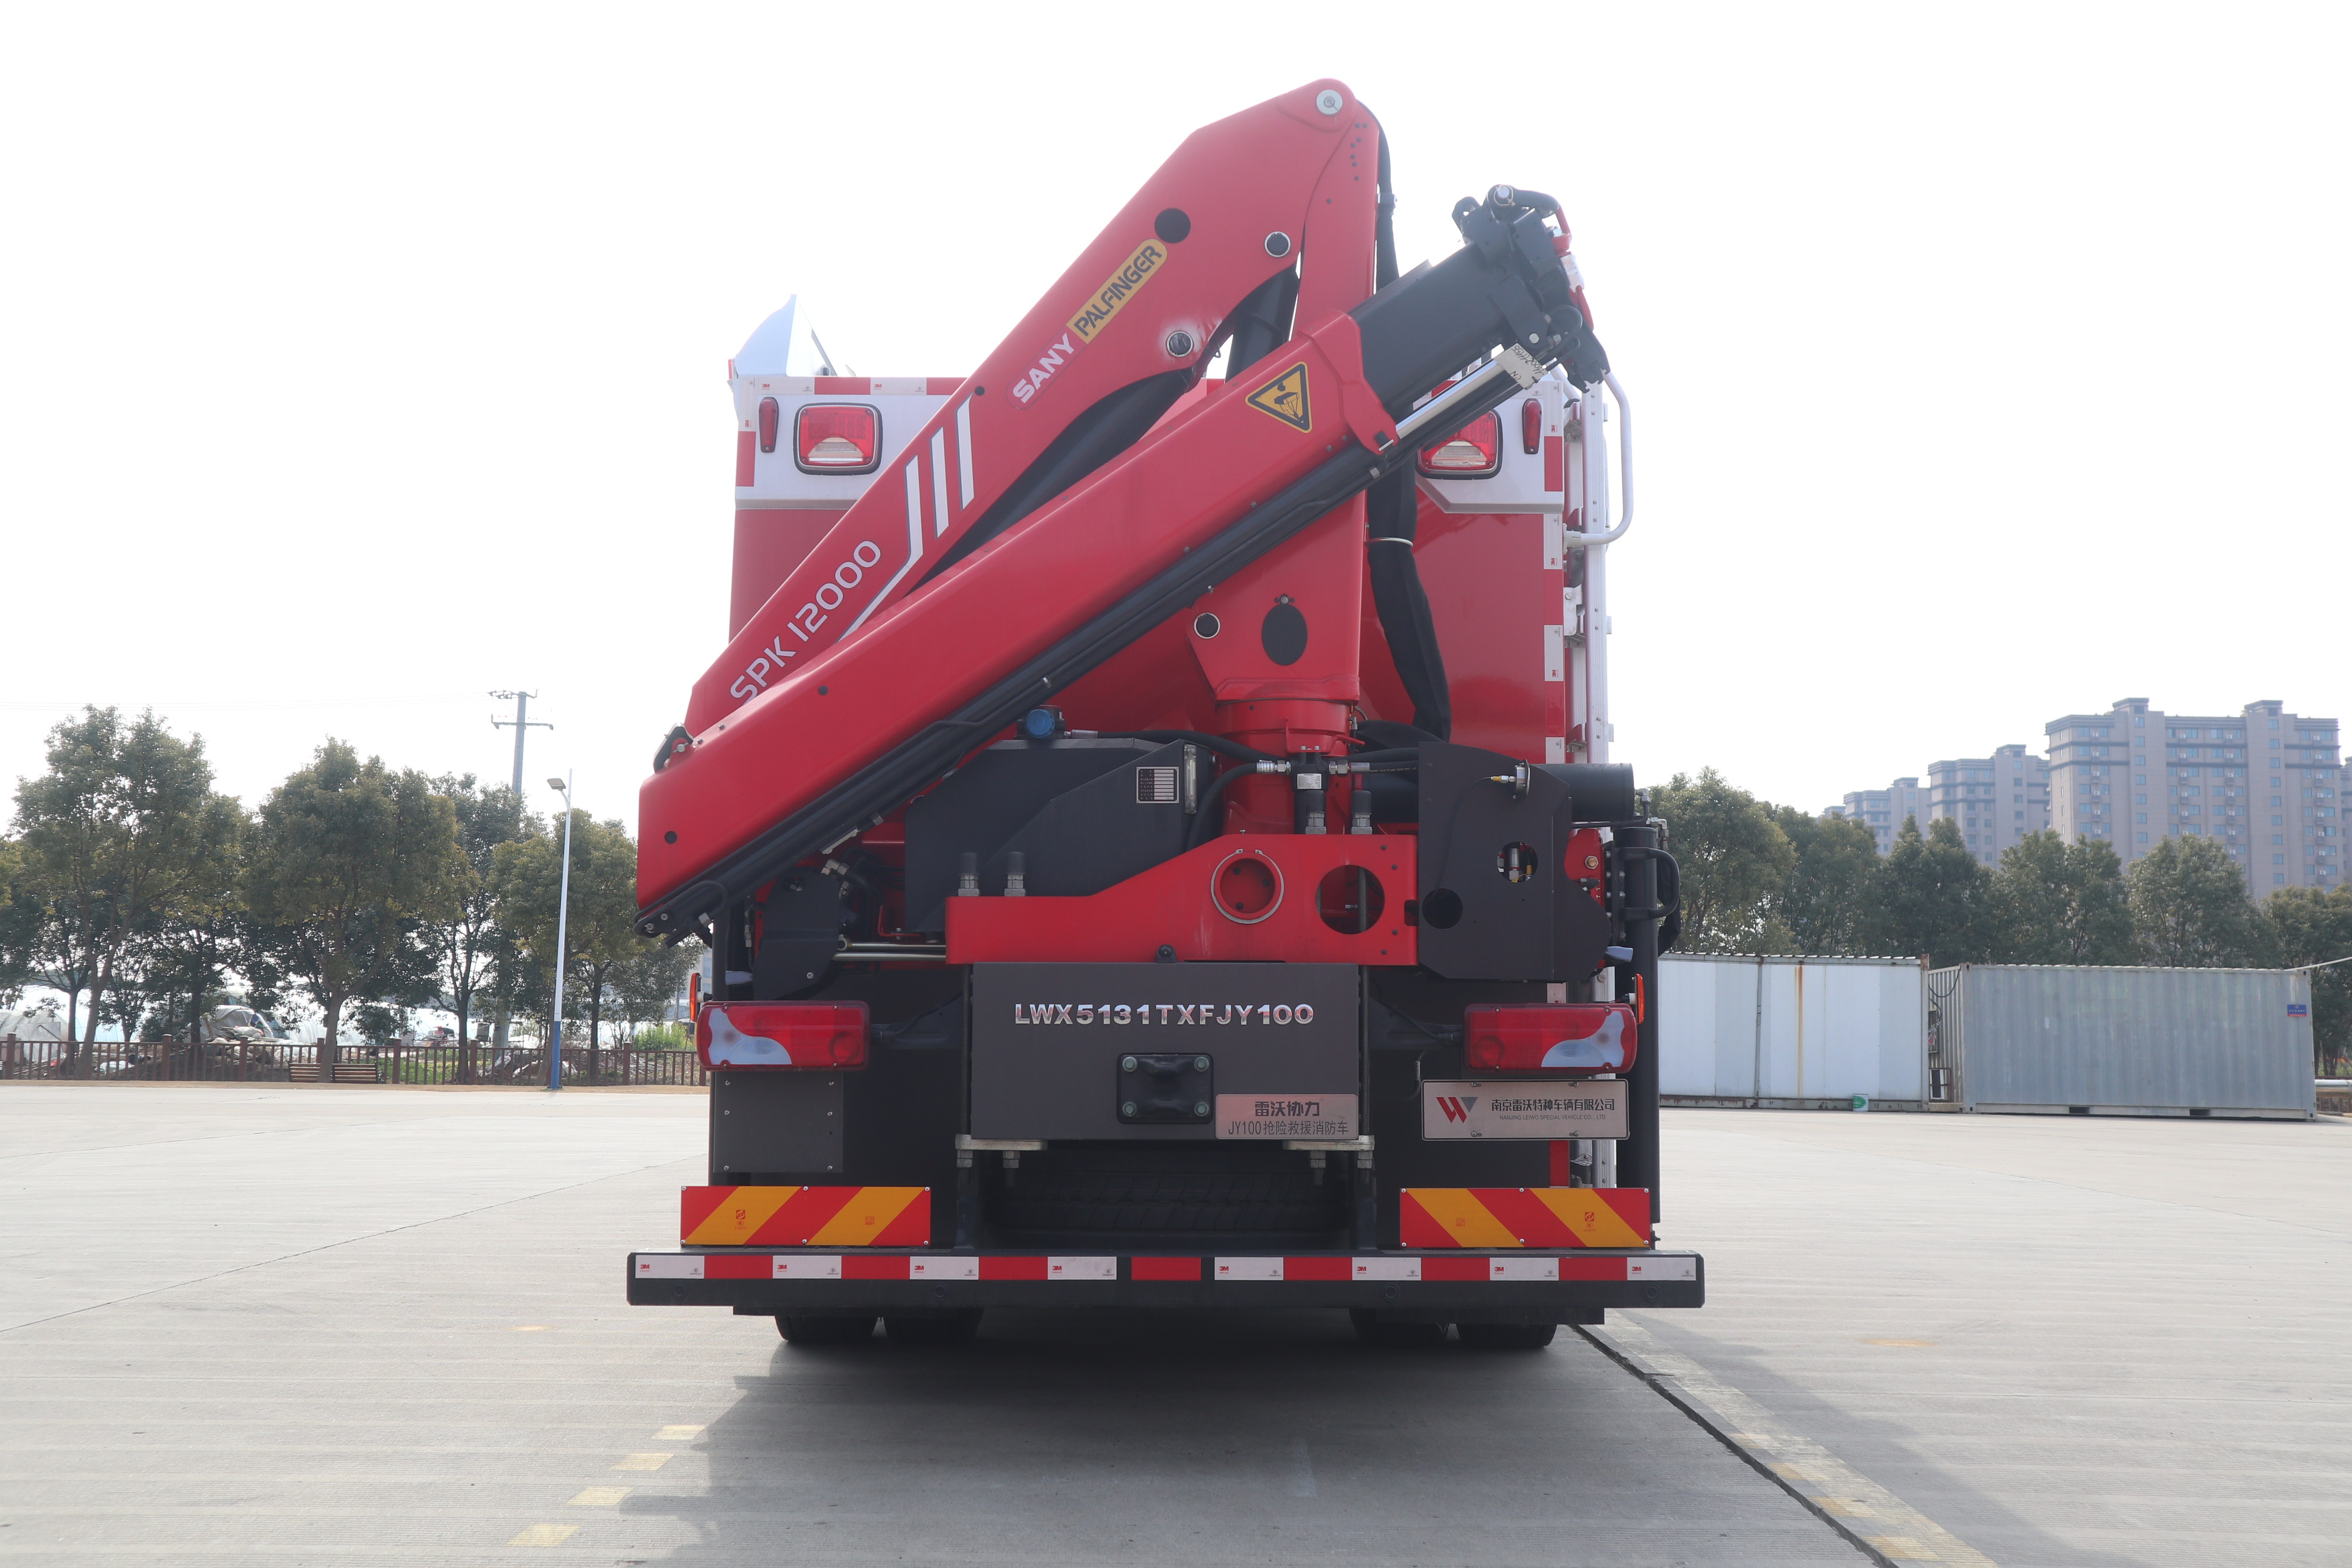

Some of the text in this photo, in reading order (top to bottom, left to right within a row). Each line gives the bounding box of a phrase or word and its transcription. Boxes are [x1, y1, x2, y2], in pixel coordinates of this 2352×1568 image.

[1012, 244, 1163, 403] SANY PALFINGER
[1550, 557, 1556, 566] 3M
[730, 540, 881, 706] SPK 12000
[1014, 1003, 1314, 1025] LWX5131TXFJY100
[1255, 1100, 1320, 1117] 雷沃协力
[1491, 1099, 1615, 1112] 南京雷沃特种车辆有限公司
[1228, 1120, 1350, 1136] JY100抢险救援消防车
